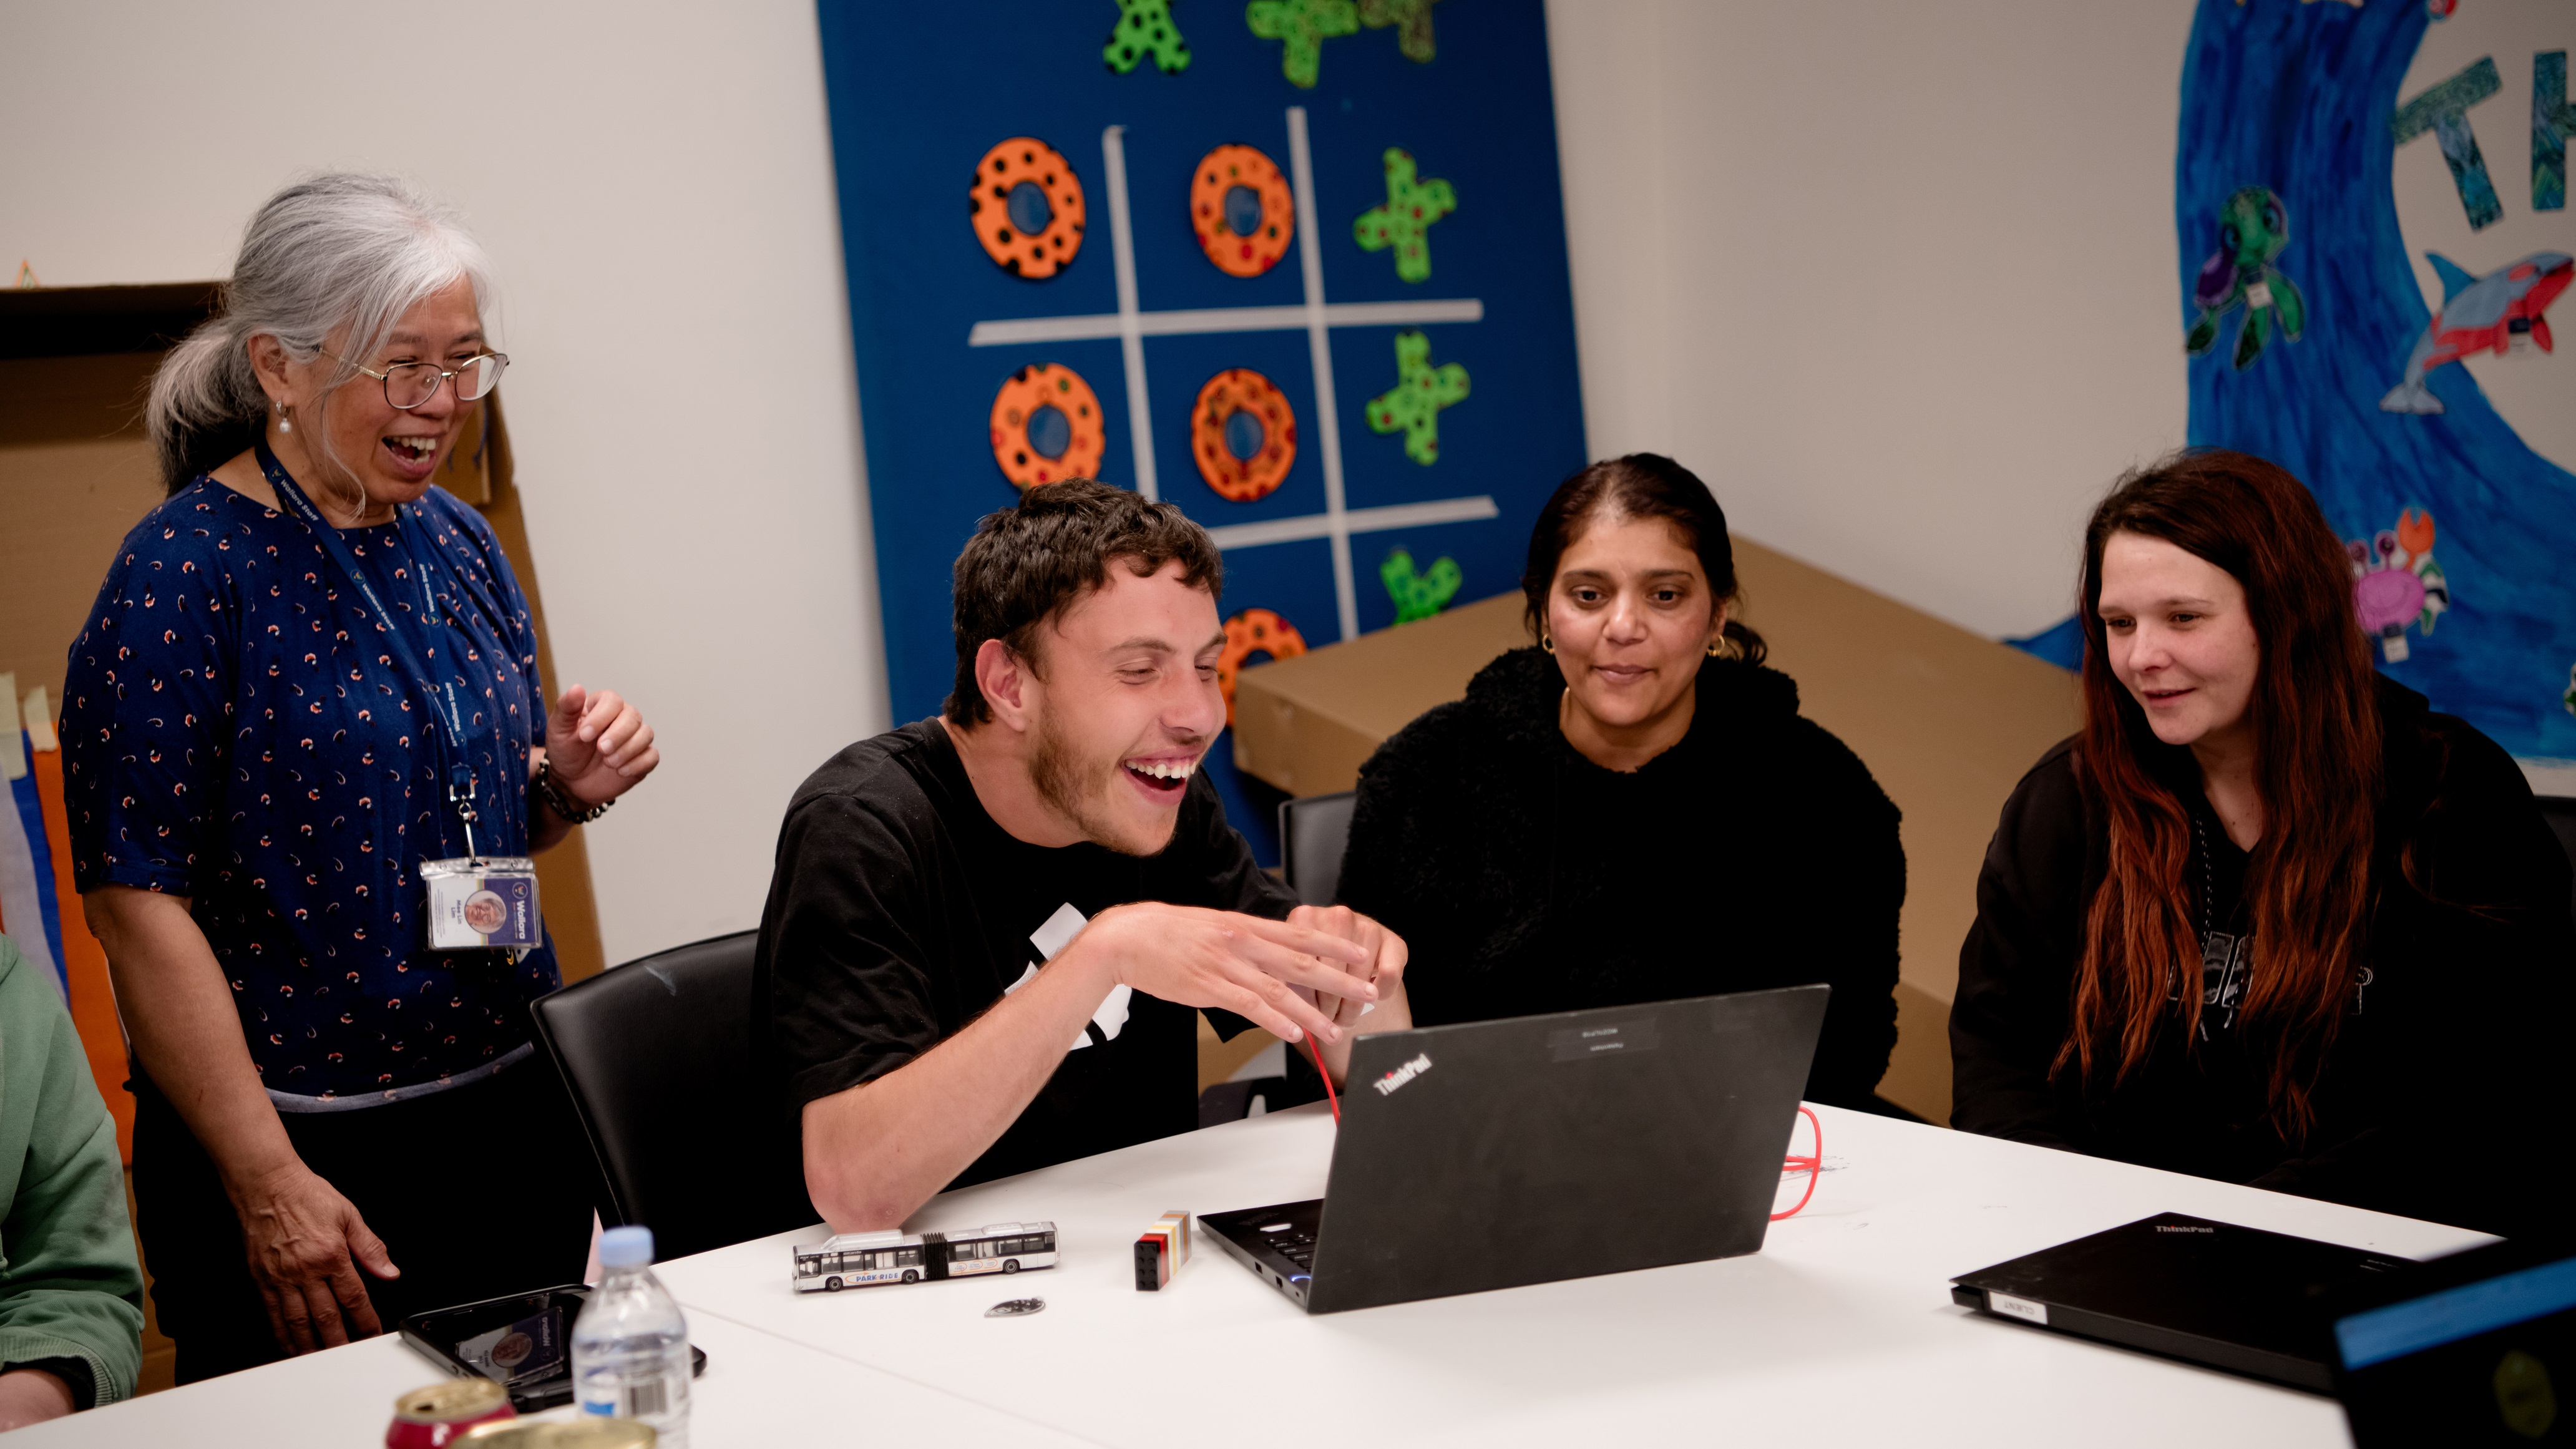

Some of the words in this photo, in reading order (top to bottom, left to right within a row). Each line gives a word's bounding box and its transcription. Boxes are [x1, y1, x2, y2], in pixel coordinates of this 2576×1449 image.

[281, 479, 303, 505] Wallara
[301, 504, 319, 521] Staff
[419, 564, 428, 583] Staff
[362, 583, 382, 612] Wallara
[381, 611, 395, 630] Staff
[425, 583, 435, 613] Wallara
[445, 682, 455, 702] Staff
[451, 701, 461, 732] Wallara
[517, 900, 526, 940] Wallara
[1373, 1053, 1432, 1096] ThinkPad
[2154, 1225, 2214, 1233] ThinkPad
